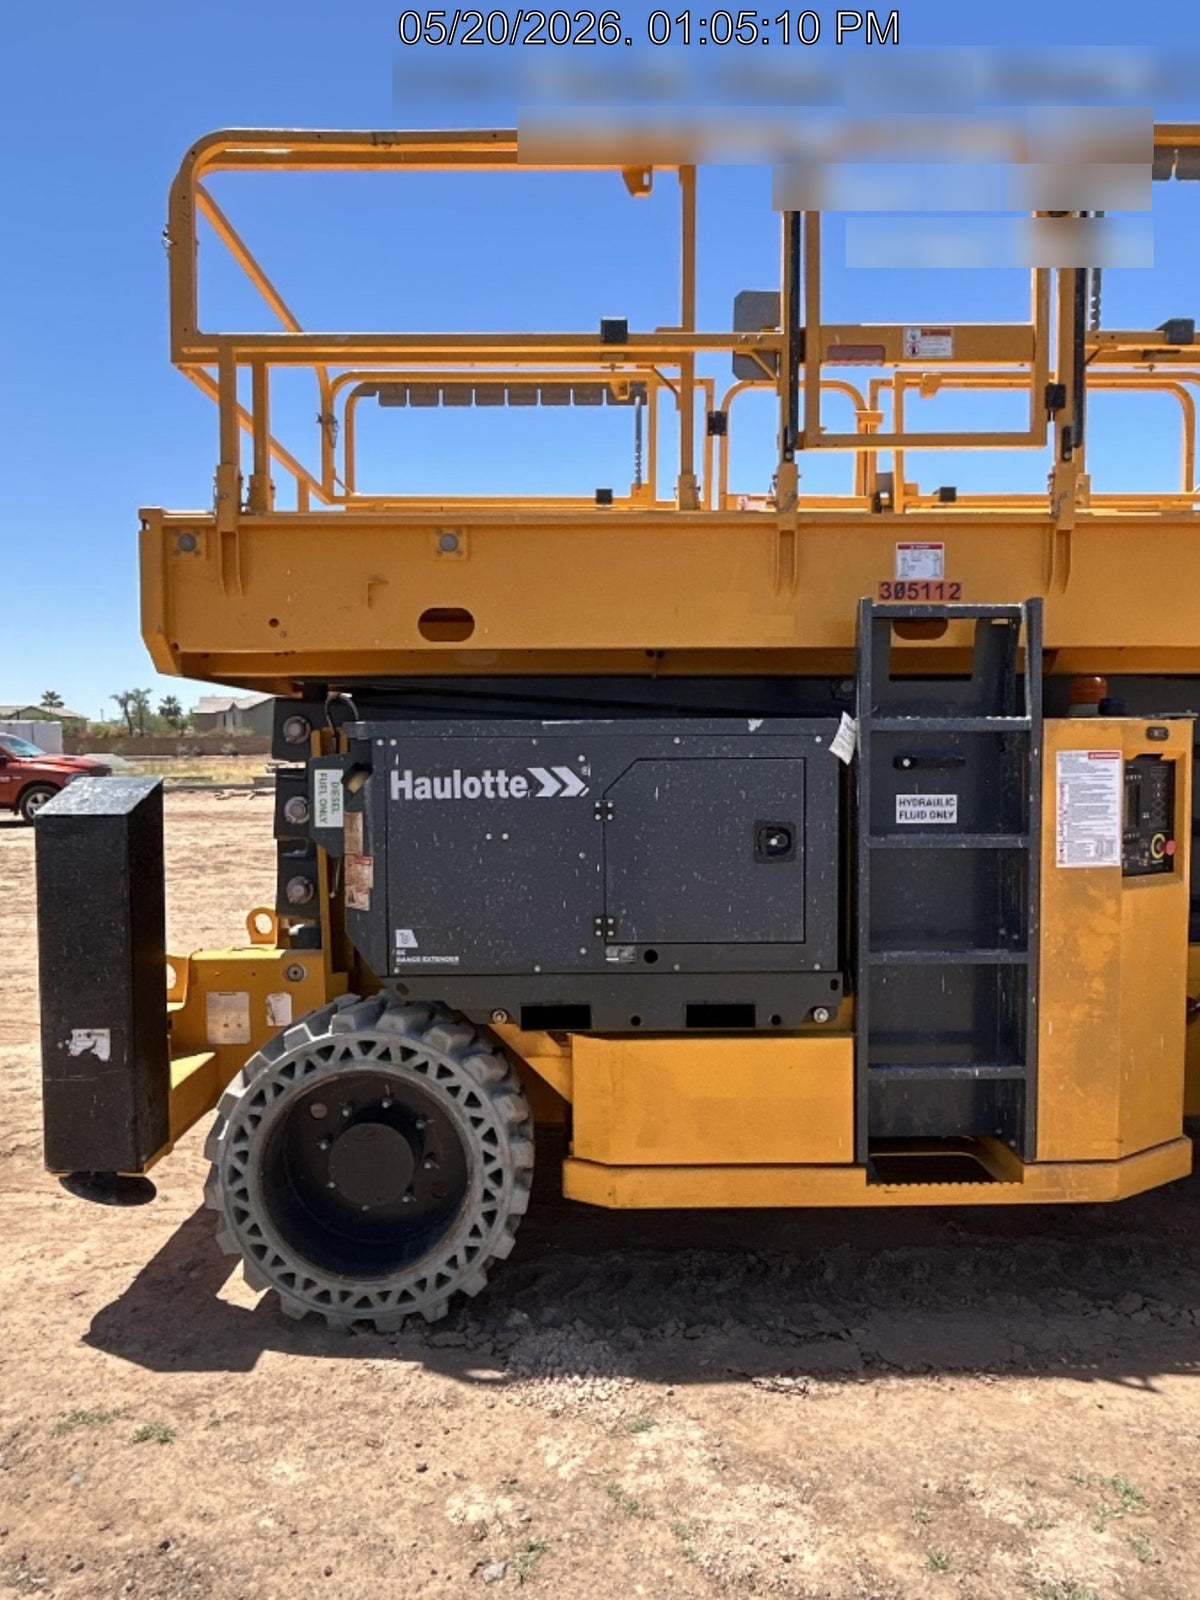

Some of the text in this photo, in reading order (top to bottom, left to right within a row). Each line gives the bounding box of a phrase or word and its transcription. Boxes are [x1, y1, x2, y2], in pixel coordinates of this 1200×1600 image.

[880, 581, 962, 600] 305112
[390, 769, 529, 800] Haulotte
[318, 772, 328, 824] FUEL ONLY
[330, 781, 341, 815] DIESEL
[899, 797, 956, 807] HYDRAULIC
[899, 810, 955, 820] FLUID ONLY
